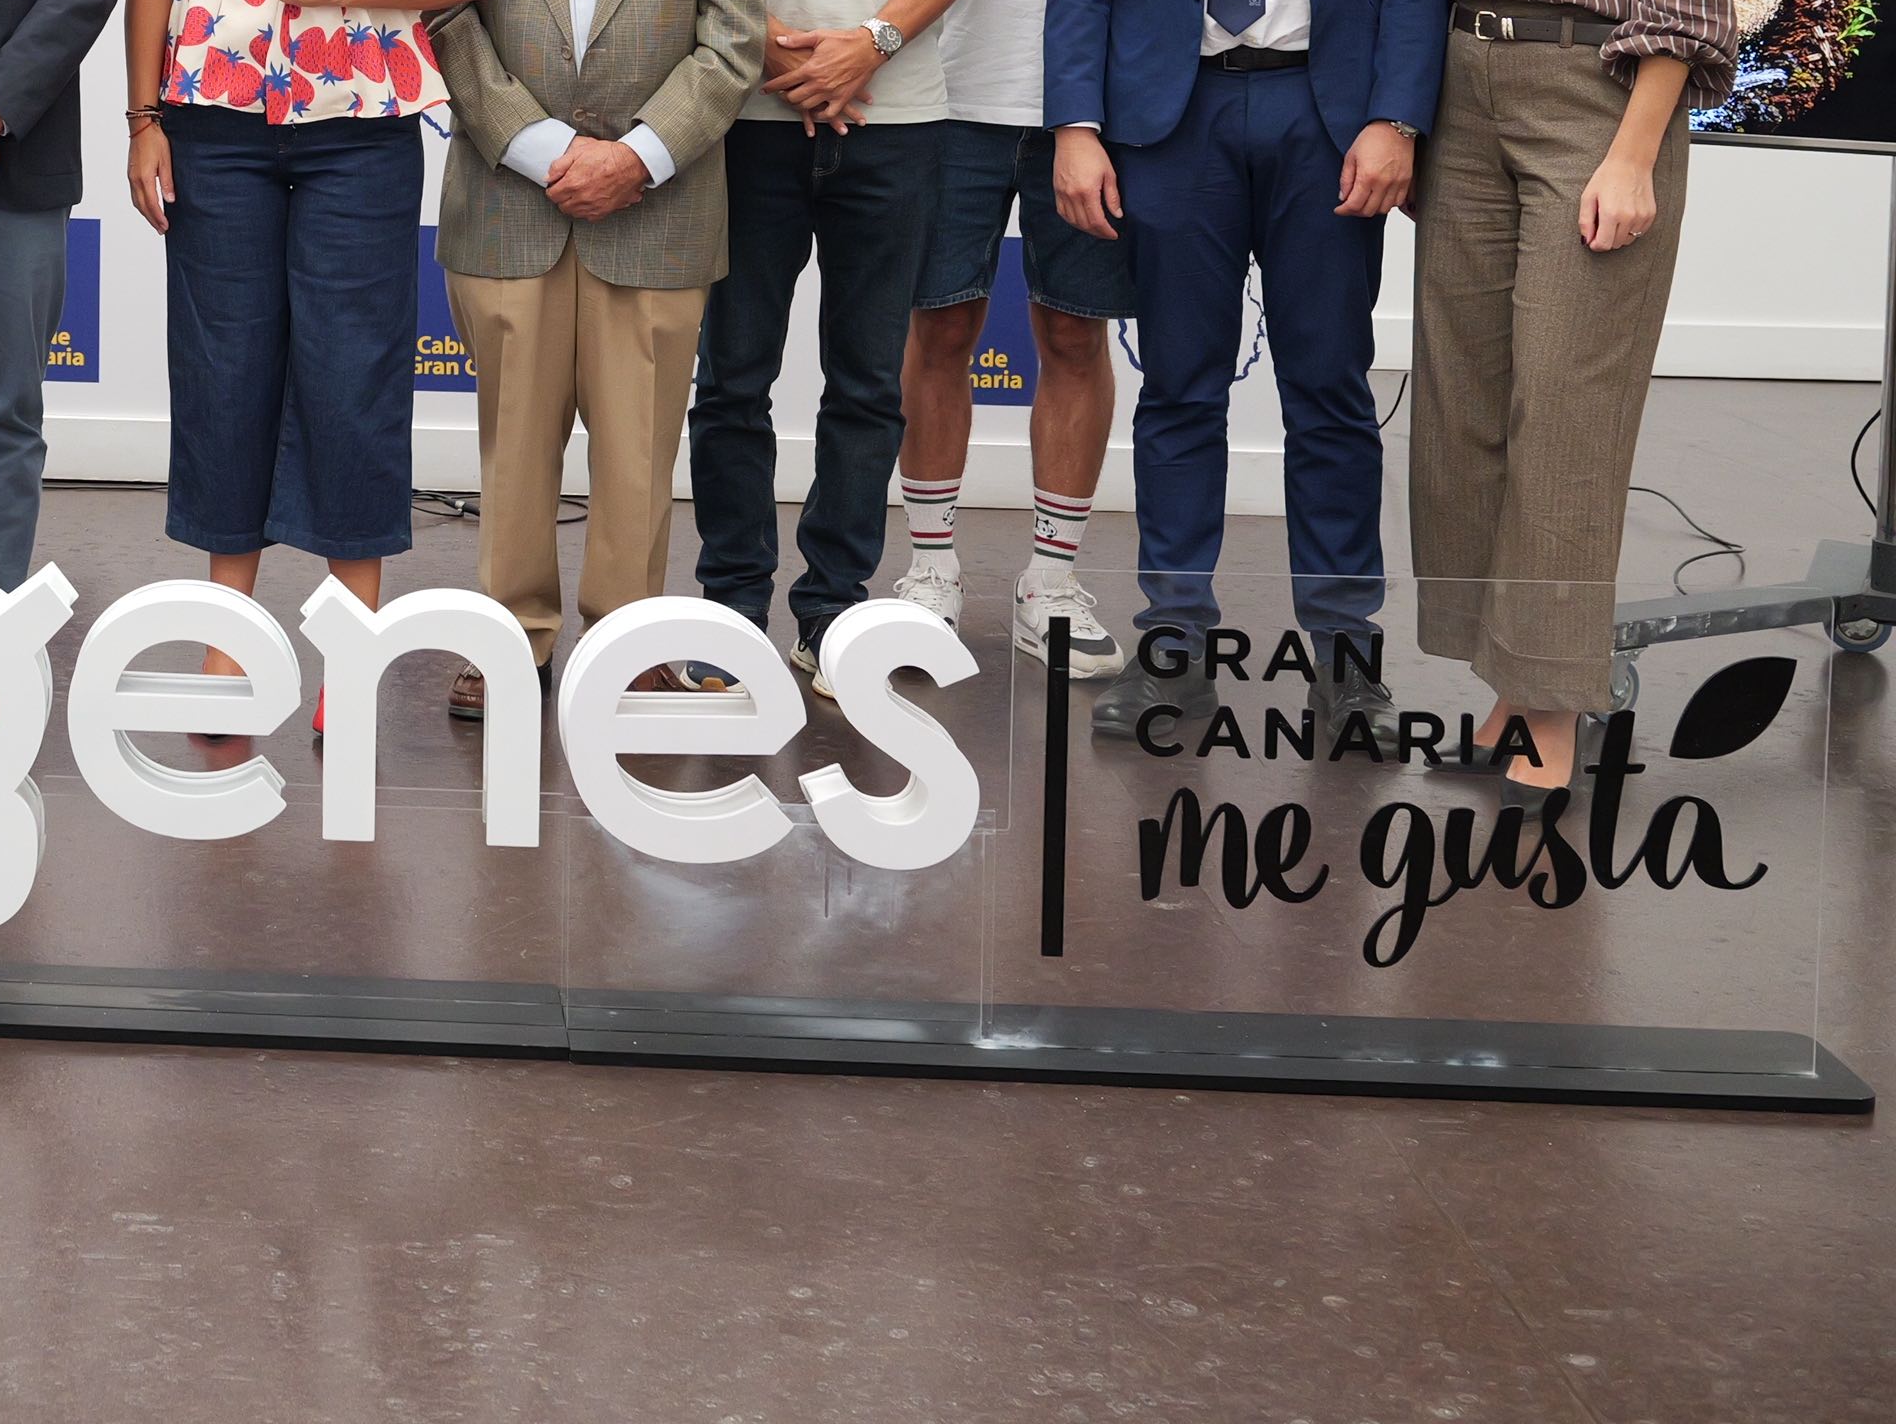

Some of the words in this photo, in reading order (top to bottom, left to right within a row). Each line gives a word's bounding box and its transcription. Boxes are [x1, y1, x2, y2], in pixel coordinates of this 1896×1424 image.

[47, 347, 85, 366] aria
[979, 348, 1008, 368] de
[968, 369, 1023, 389] naria
[1135, 624, 1384, 685] GRAN
[1135, 704, 1545, 769] CANARIA
[1137, 786, 1330, 910] me
[1359, 709, 1769, 968] gusta
